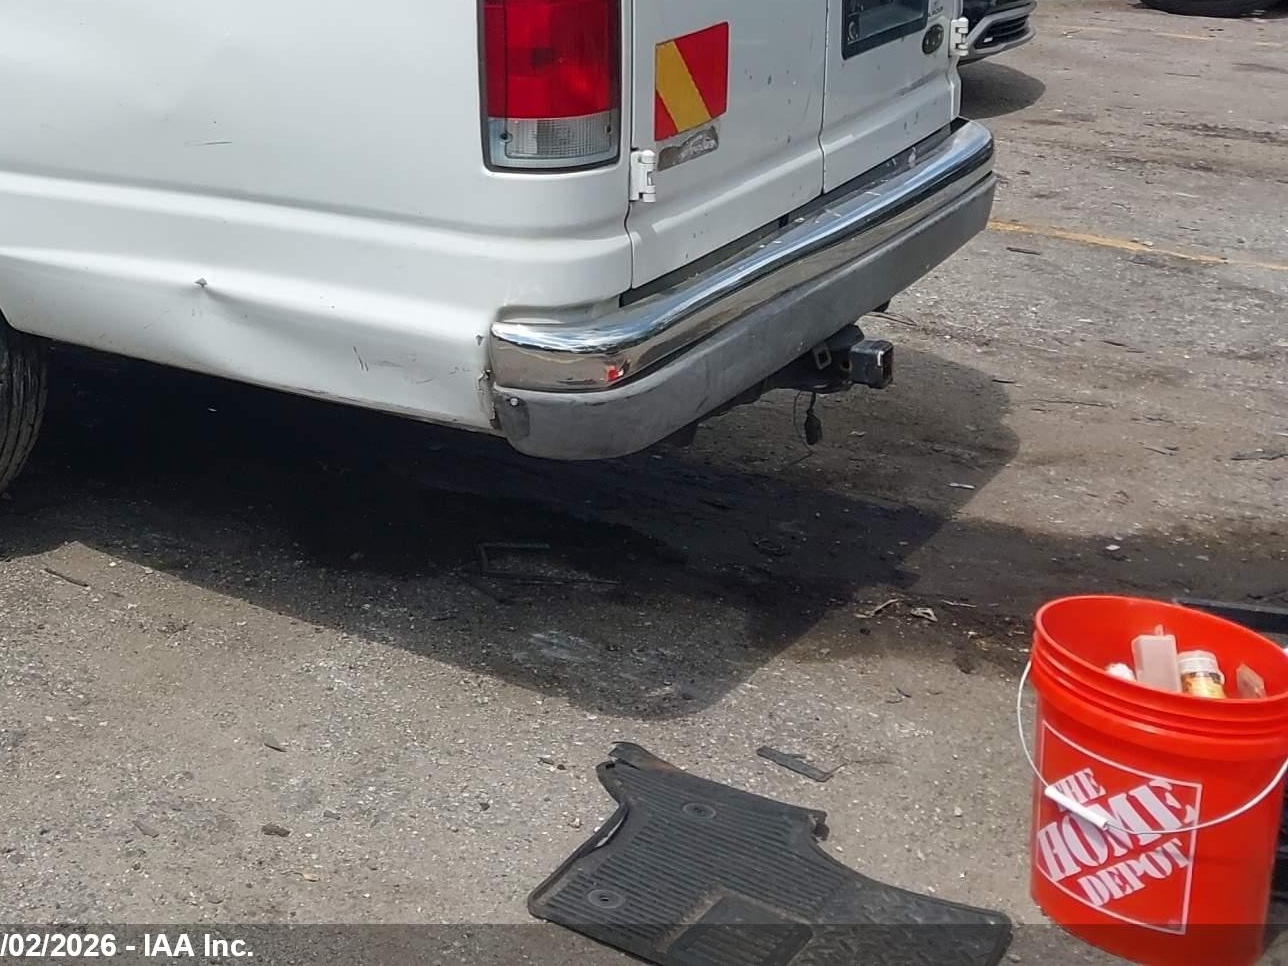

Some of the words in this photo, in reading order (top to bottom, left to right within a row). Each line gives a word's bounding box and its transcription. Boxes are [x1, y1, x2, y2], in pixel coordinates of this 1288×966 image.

[1050, 768, 1107, 812] THE
[1037, 778, 1196, 882] HOME
[1077, 837, 1190, 907] DEPOT
